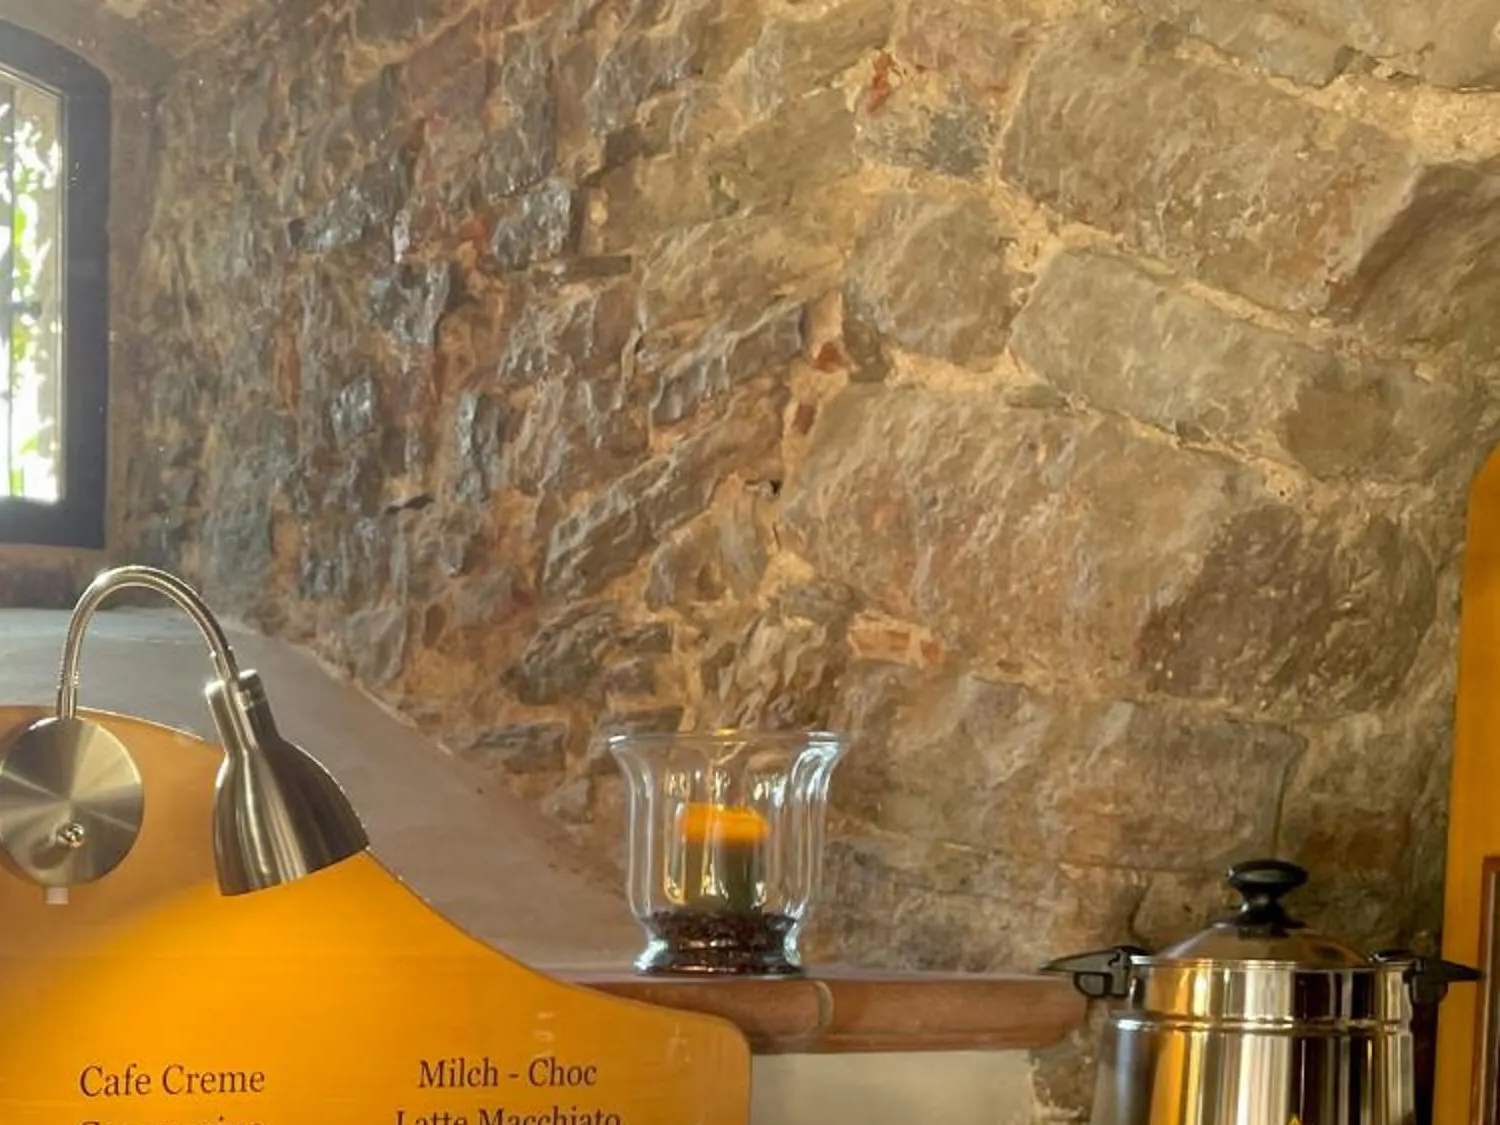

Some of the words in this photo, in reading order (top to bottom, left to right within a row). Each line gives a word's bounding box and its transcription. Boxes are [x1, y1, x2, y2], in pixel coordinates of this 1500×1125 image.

[79, 1063, 152, 1098] Cafe
[161, 1063, 266, 1096] Creme
[416, 1058, 499, 1089] Milch
[527, 1057, 598, 1088] Choc
